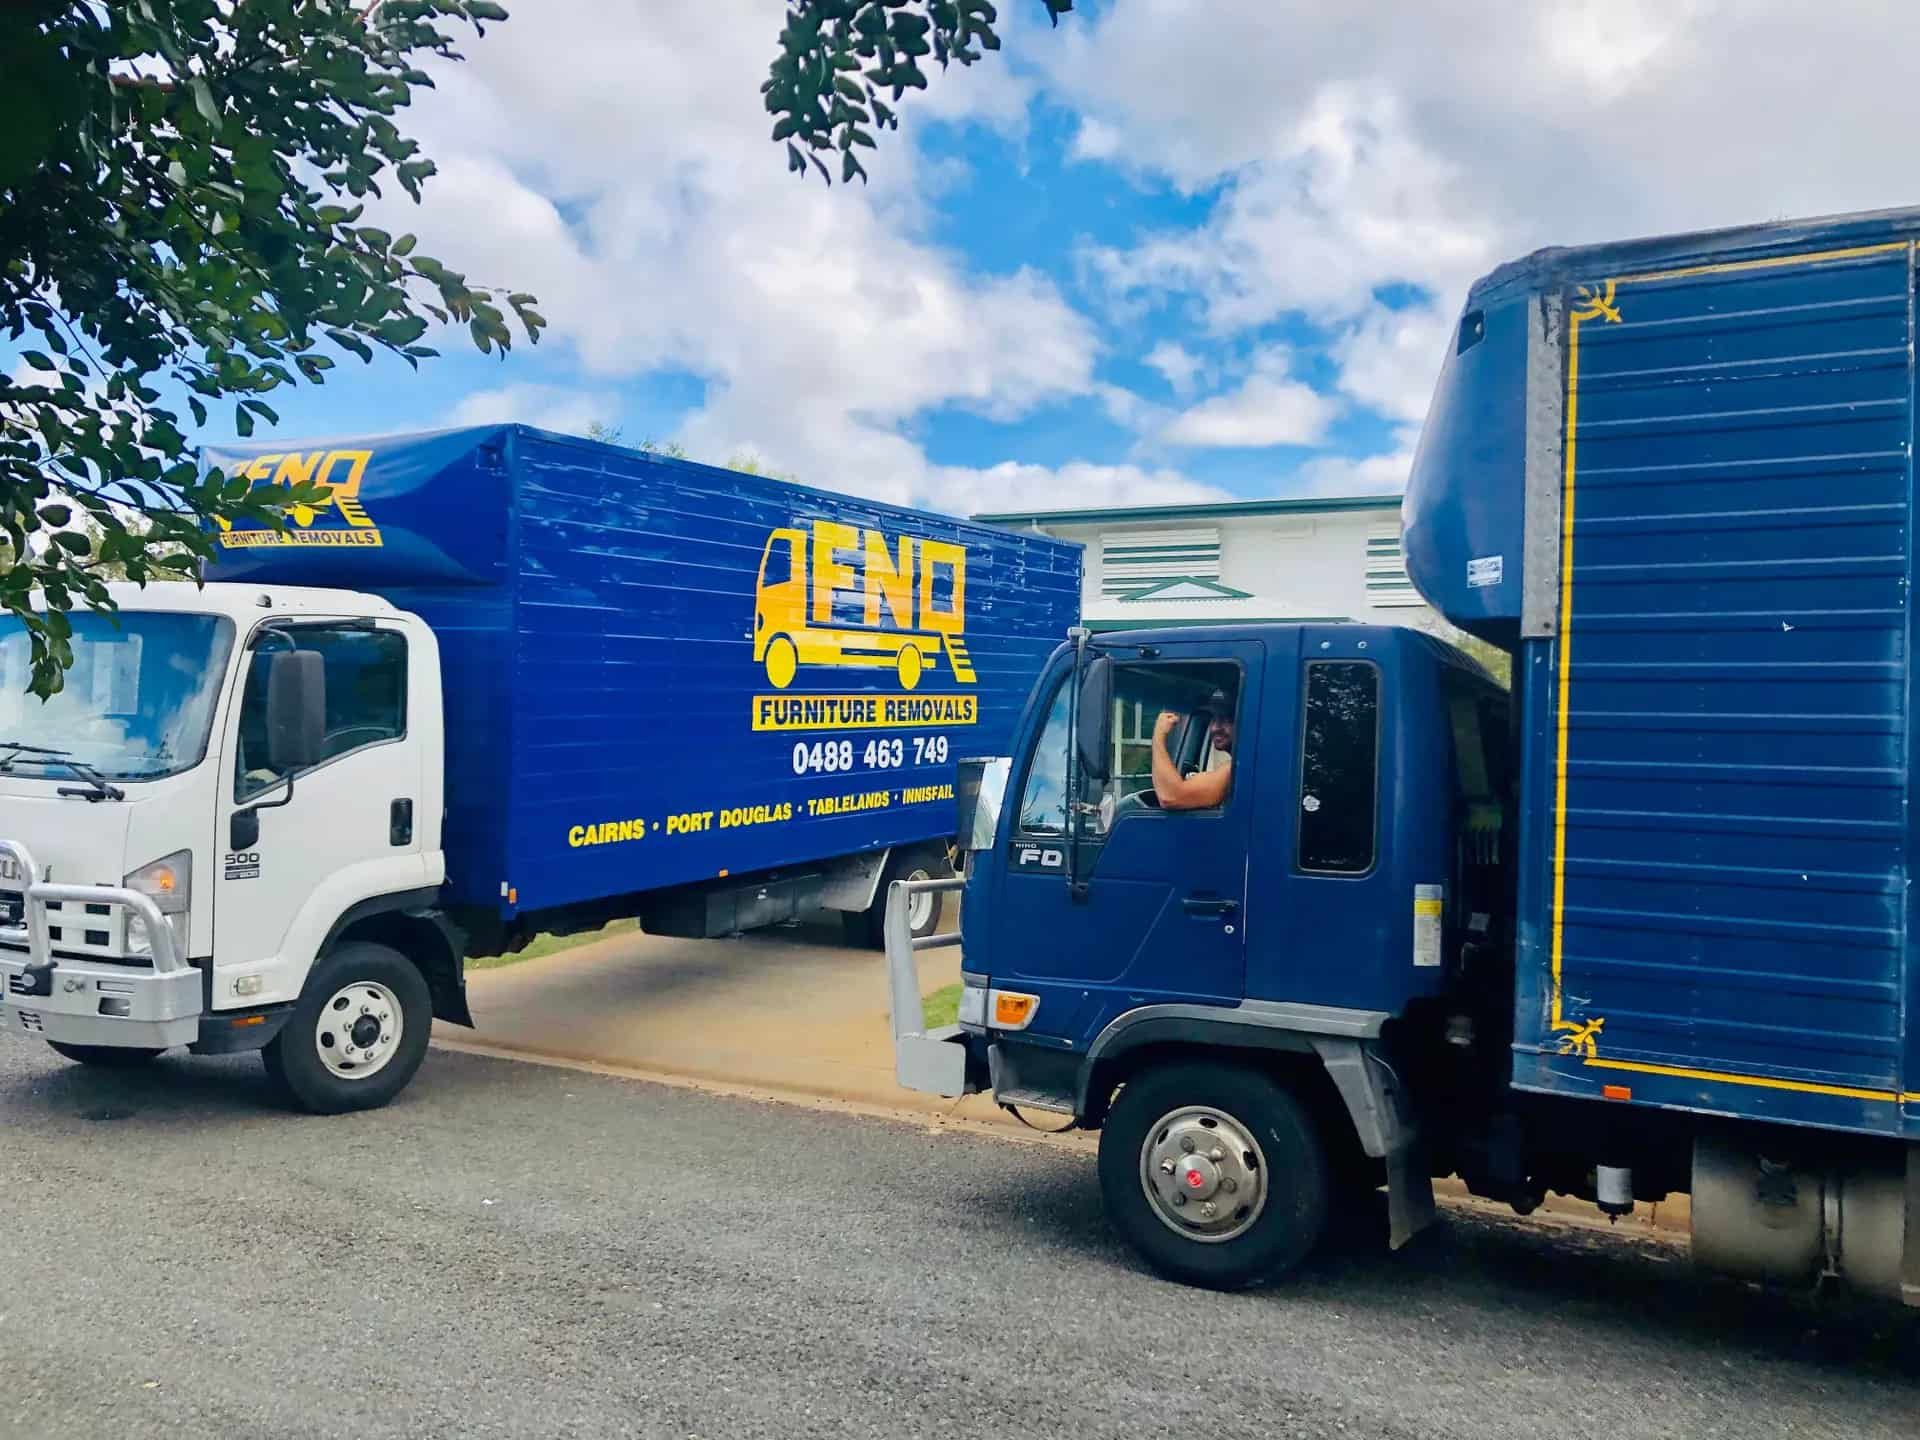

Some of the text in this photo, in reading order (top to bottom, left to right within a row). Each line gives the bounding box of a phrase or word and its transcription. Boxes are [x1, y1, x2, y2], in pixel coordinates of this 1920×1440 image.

[760, 699, 973, 726] FURNITURE REMOVALS
[792, 736, 949, 774] 0488 463 749
[569, 784, 955, 847] CAIRNS PORT DOUGLAS TABLELANDS INNISFAIL
[225, 852, 261, 864] 500
